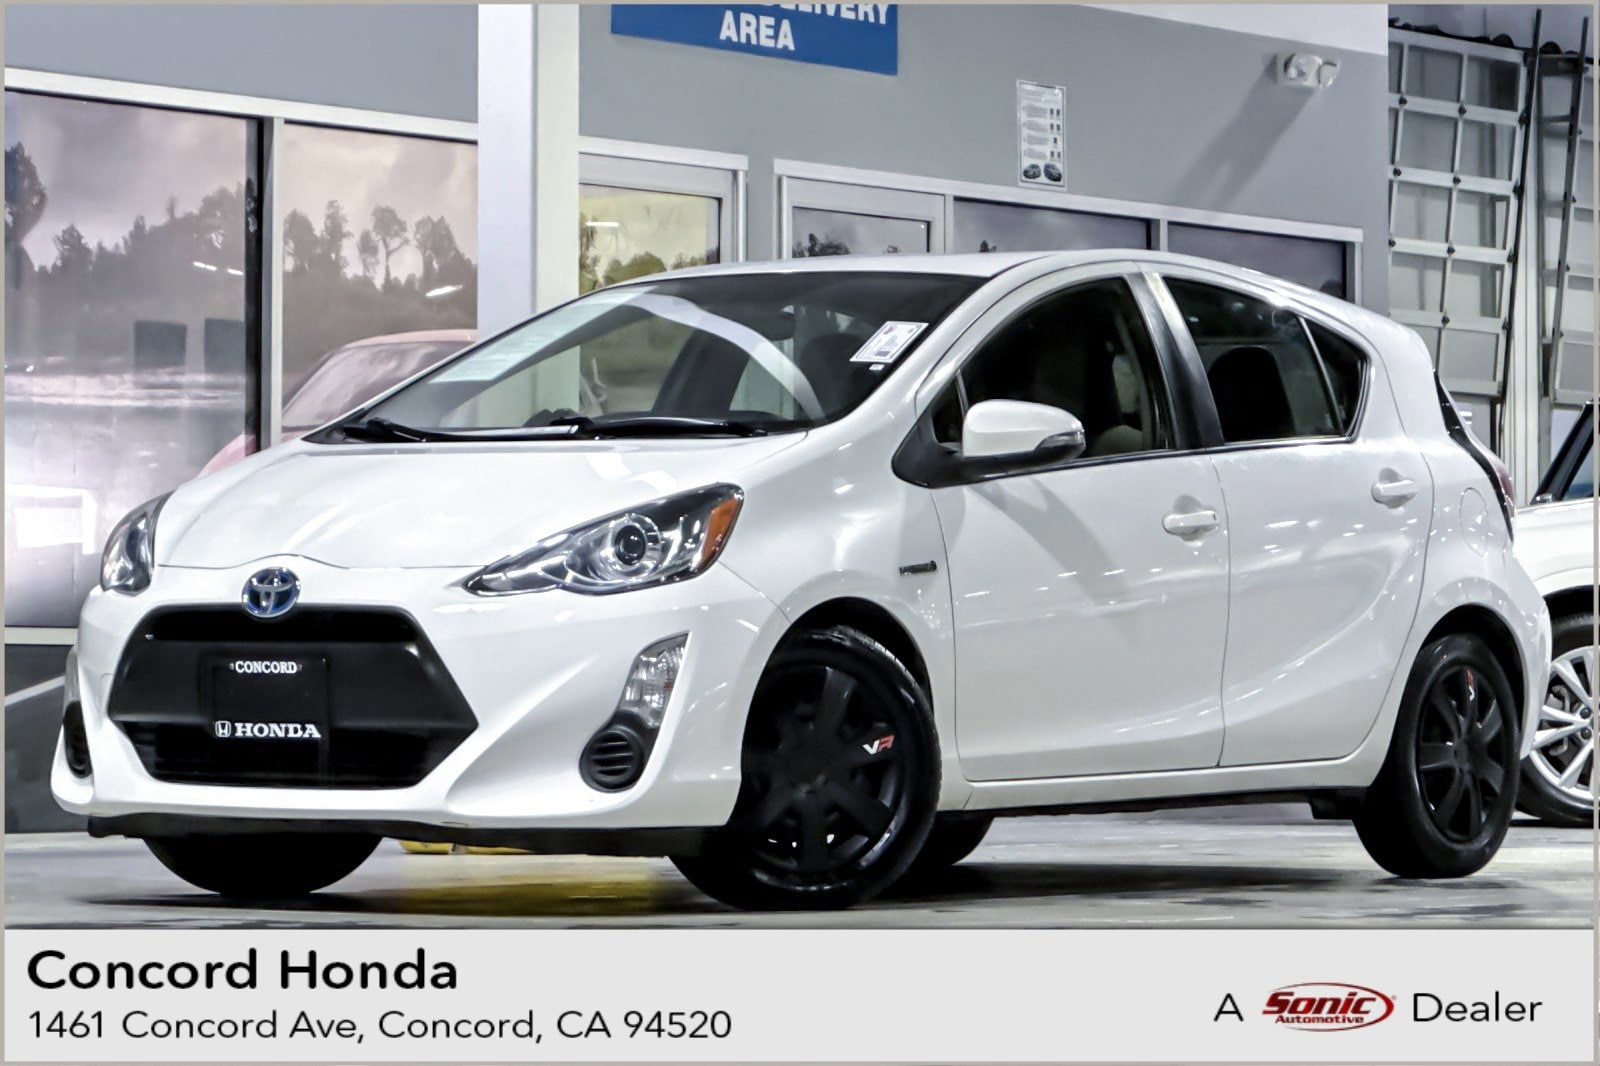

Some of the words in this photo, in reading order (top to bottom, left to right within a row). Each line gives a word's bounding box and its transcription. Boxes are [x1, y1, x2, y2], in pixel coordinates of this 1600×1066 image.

[761, 4, 889, 25] VERY
[719, 9, 796, 51] AREA
[235, 660, 298, 674] CONCORD
[234, 722, 322, 738] HONDA
